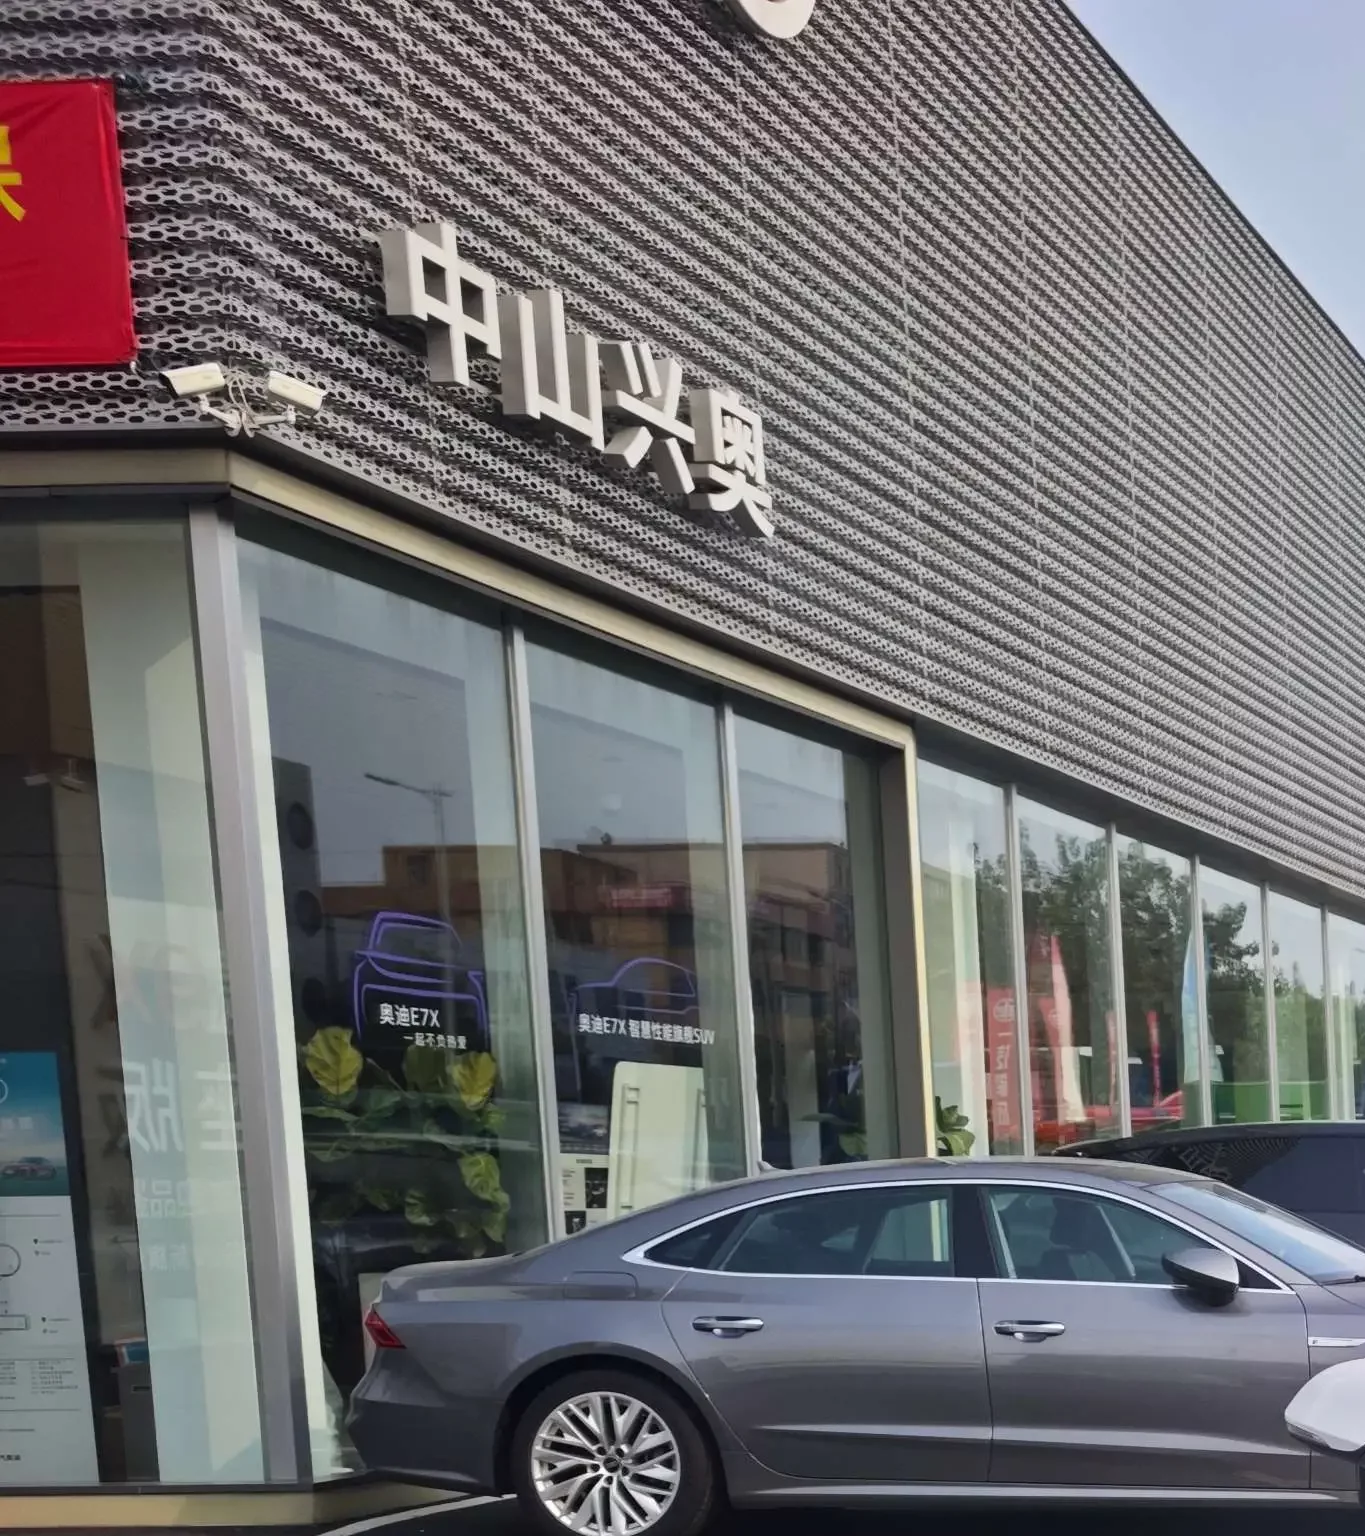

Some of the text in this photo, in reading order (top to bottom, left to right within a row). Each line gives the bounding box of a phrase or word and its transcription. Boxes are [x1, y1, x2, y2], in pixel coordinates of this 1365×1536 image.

[380, 222, 774, 538] 中山兴奥
[380, 1003, 440, 1028] 奥迪E7X
[579, 1013, 627, 1036] 奥迪E7X
